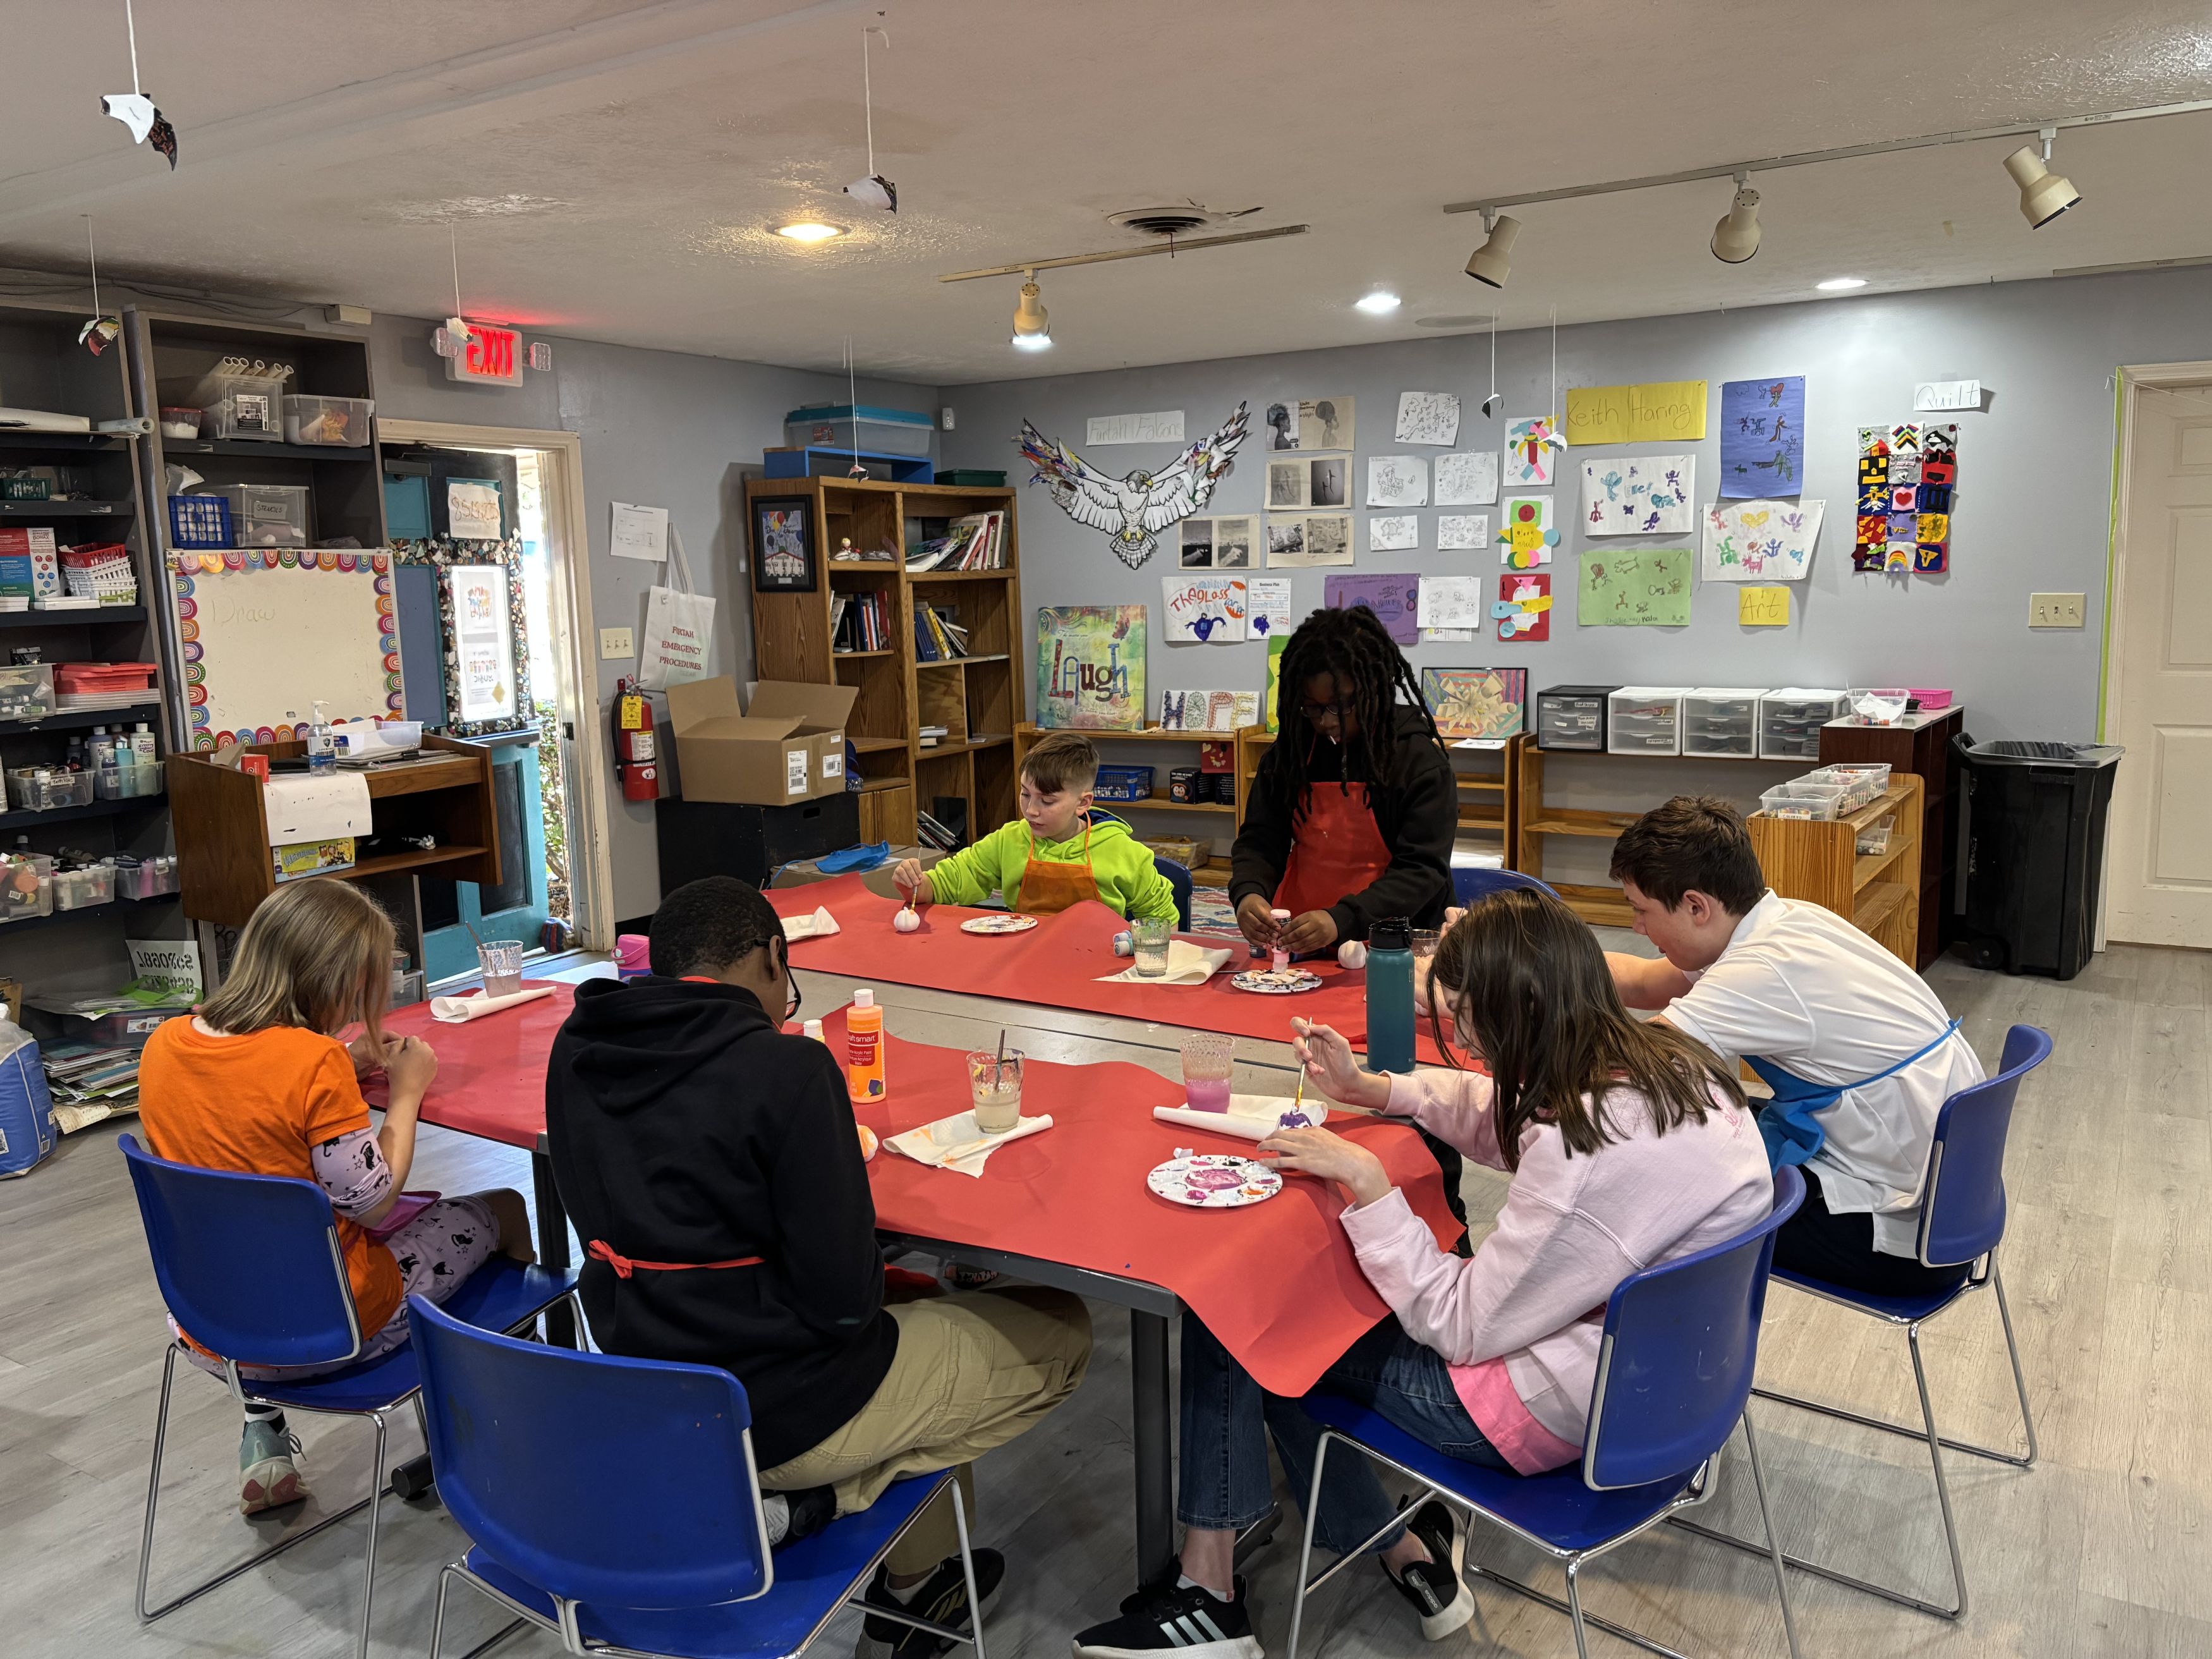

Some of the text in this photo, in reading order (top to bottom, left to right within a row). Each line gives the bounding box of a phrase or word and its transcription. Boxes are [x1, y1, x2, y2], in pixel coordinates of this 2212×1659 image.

[466, 325, 515, 378] EXIT
[1916, 382, 1979, 408] Quilt
[1567, 393, 1691, 430] Keith Haring
[1088, 413, 1184, 442] Furtah Falcons
[1170, 588, 1196, 612] The
[1741, 593, 1781, 621] Art
[662, 641, 702, 655] EMERGENCY
[659, 656, 702, 670] PROCEDURES
